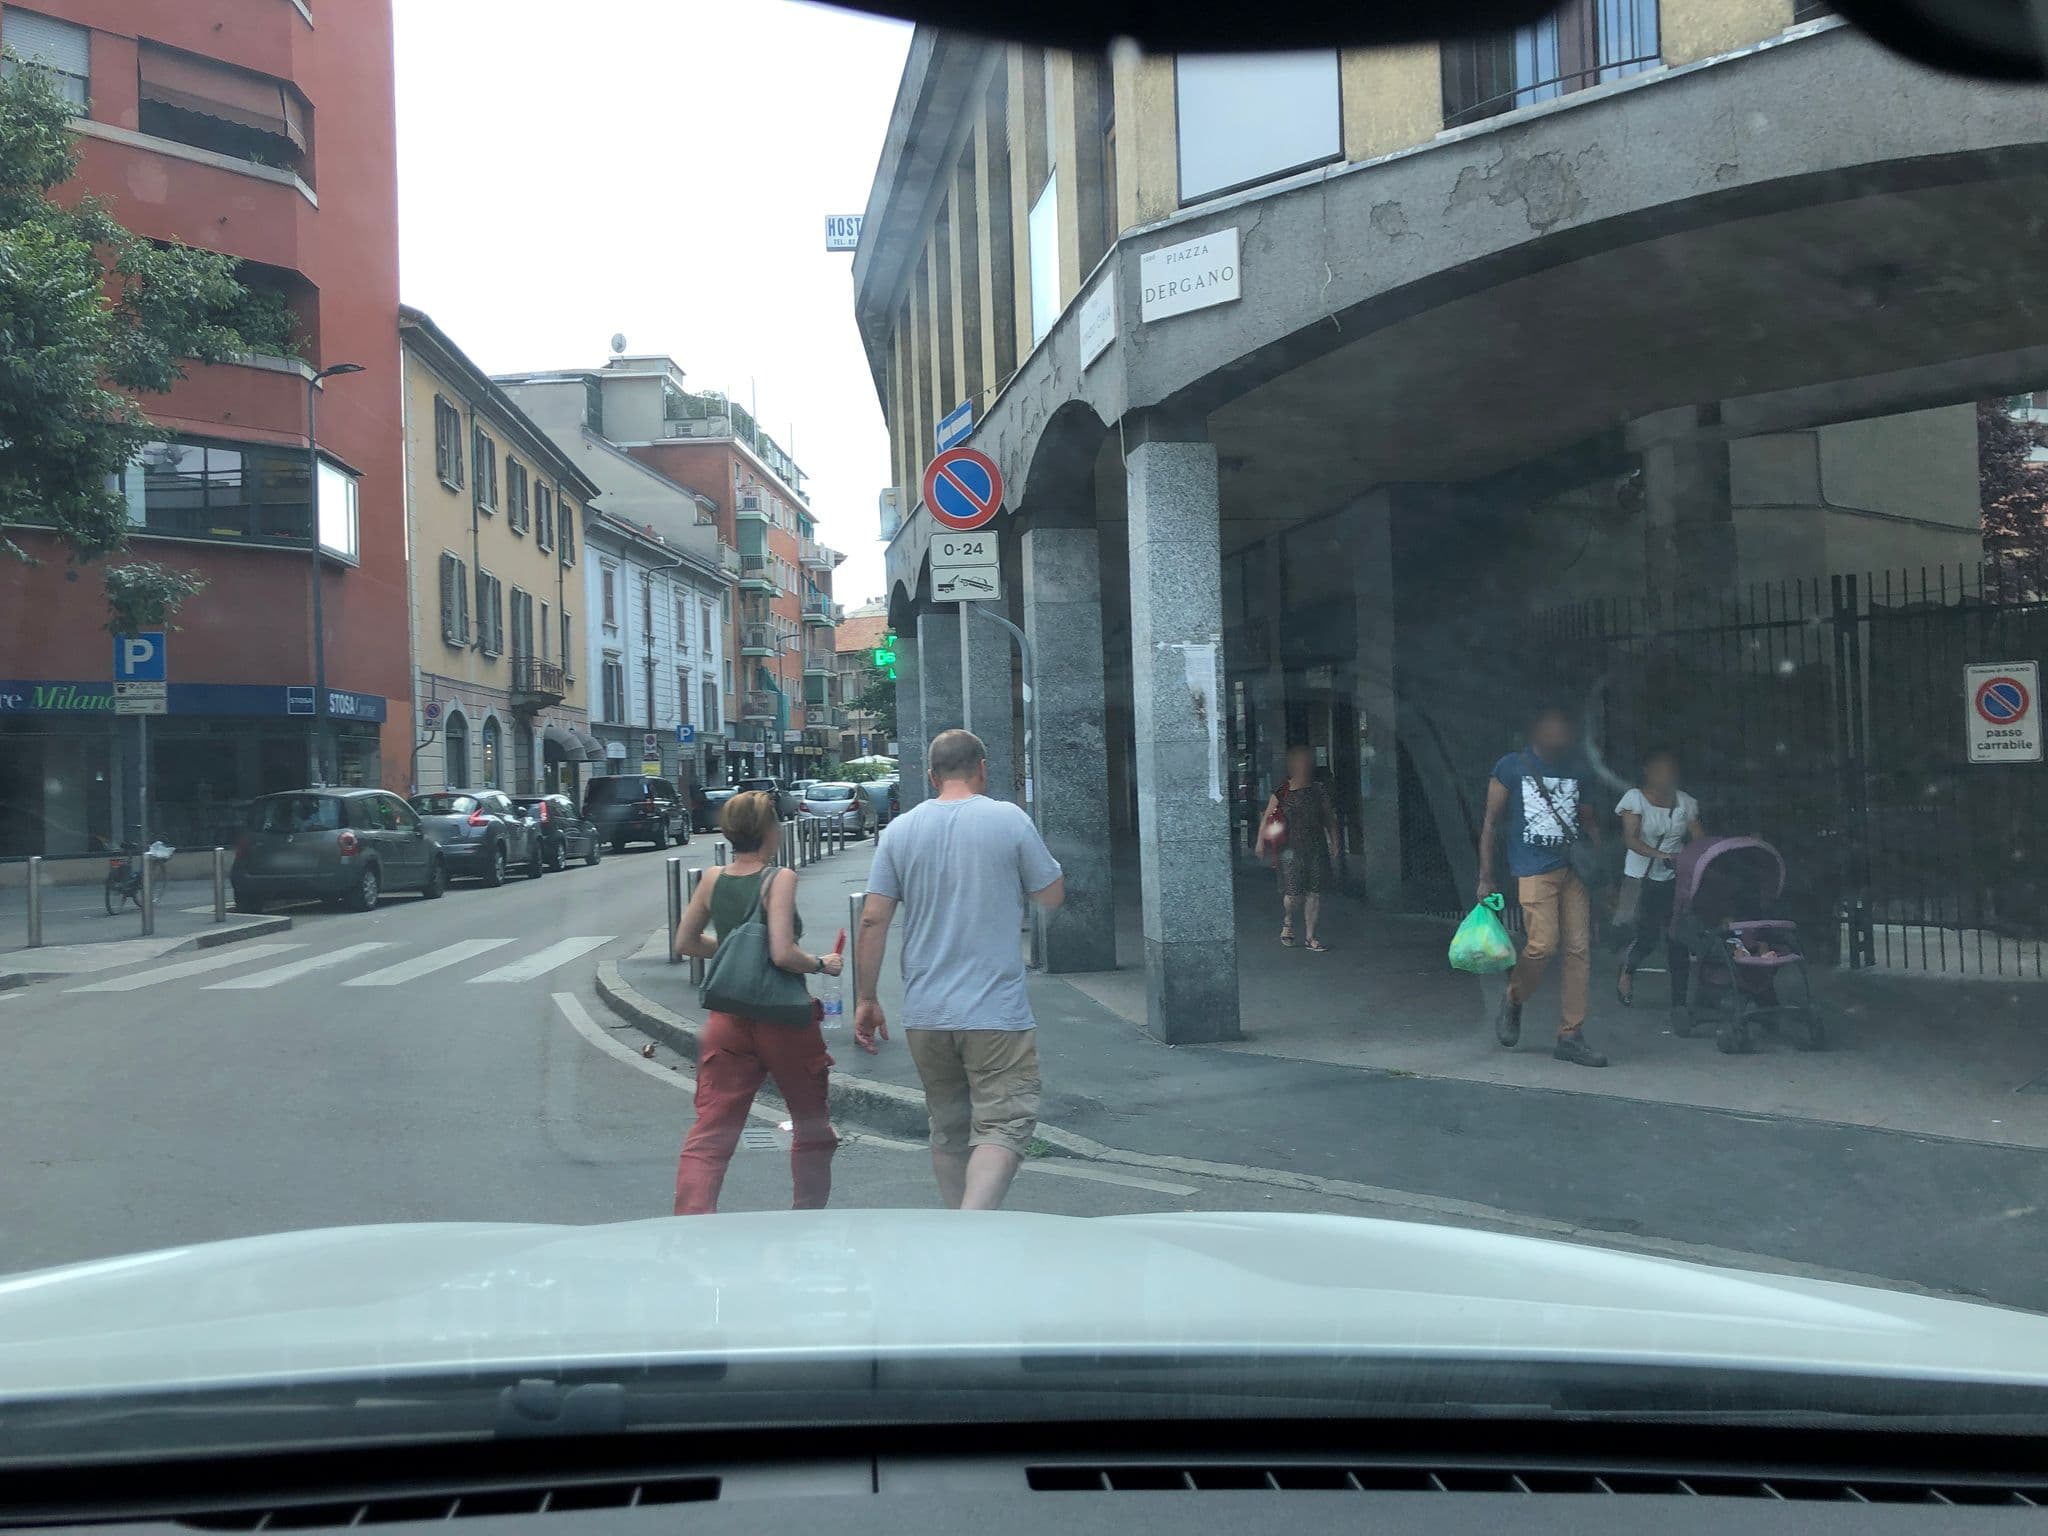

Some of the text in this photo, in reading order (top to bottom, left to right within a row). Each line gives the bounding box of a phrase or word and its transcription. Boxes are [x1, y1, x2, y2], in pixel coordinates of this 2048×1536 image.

[1166, 245, 1209, 264] PIAZZA
[1145, 266, 1234, 303] DERGANO
[944, 542, 984, 556] 0-24
[124, 638, 154, 674] P
[329, 692, 356, 715] STOSA
[680, 727, 691, 741] P
[1986, 728, 2023, 738] passo
[1977, 740, 2033, 750] carrabile
